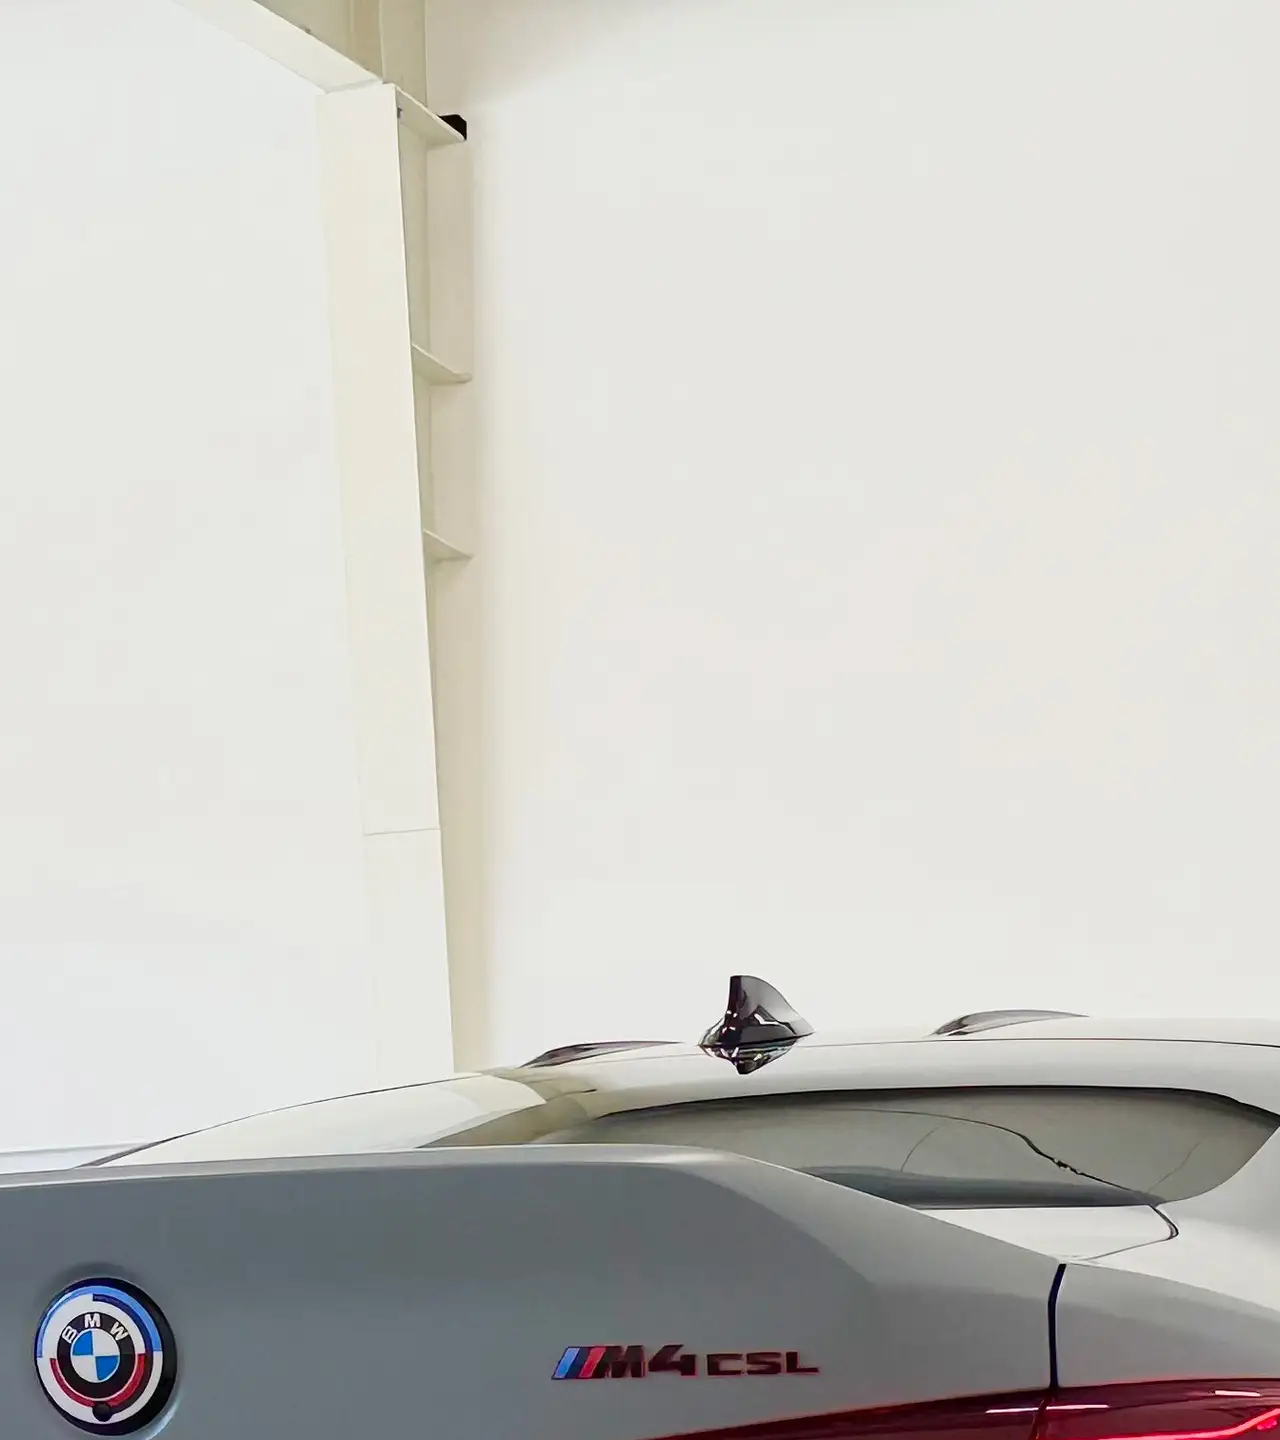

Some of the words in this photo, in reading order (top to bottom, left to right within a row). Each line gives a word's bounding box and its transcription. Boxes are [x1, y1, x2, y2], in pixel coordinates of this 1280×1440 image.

[61, 1312, 128, 1344] BMW
[591, 1344, 698, 1378] M4
[706, 1351, 819, 1376] CSL
